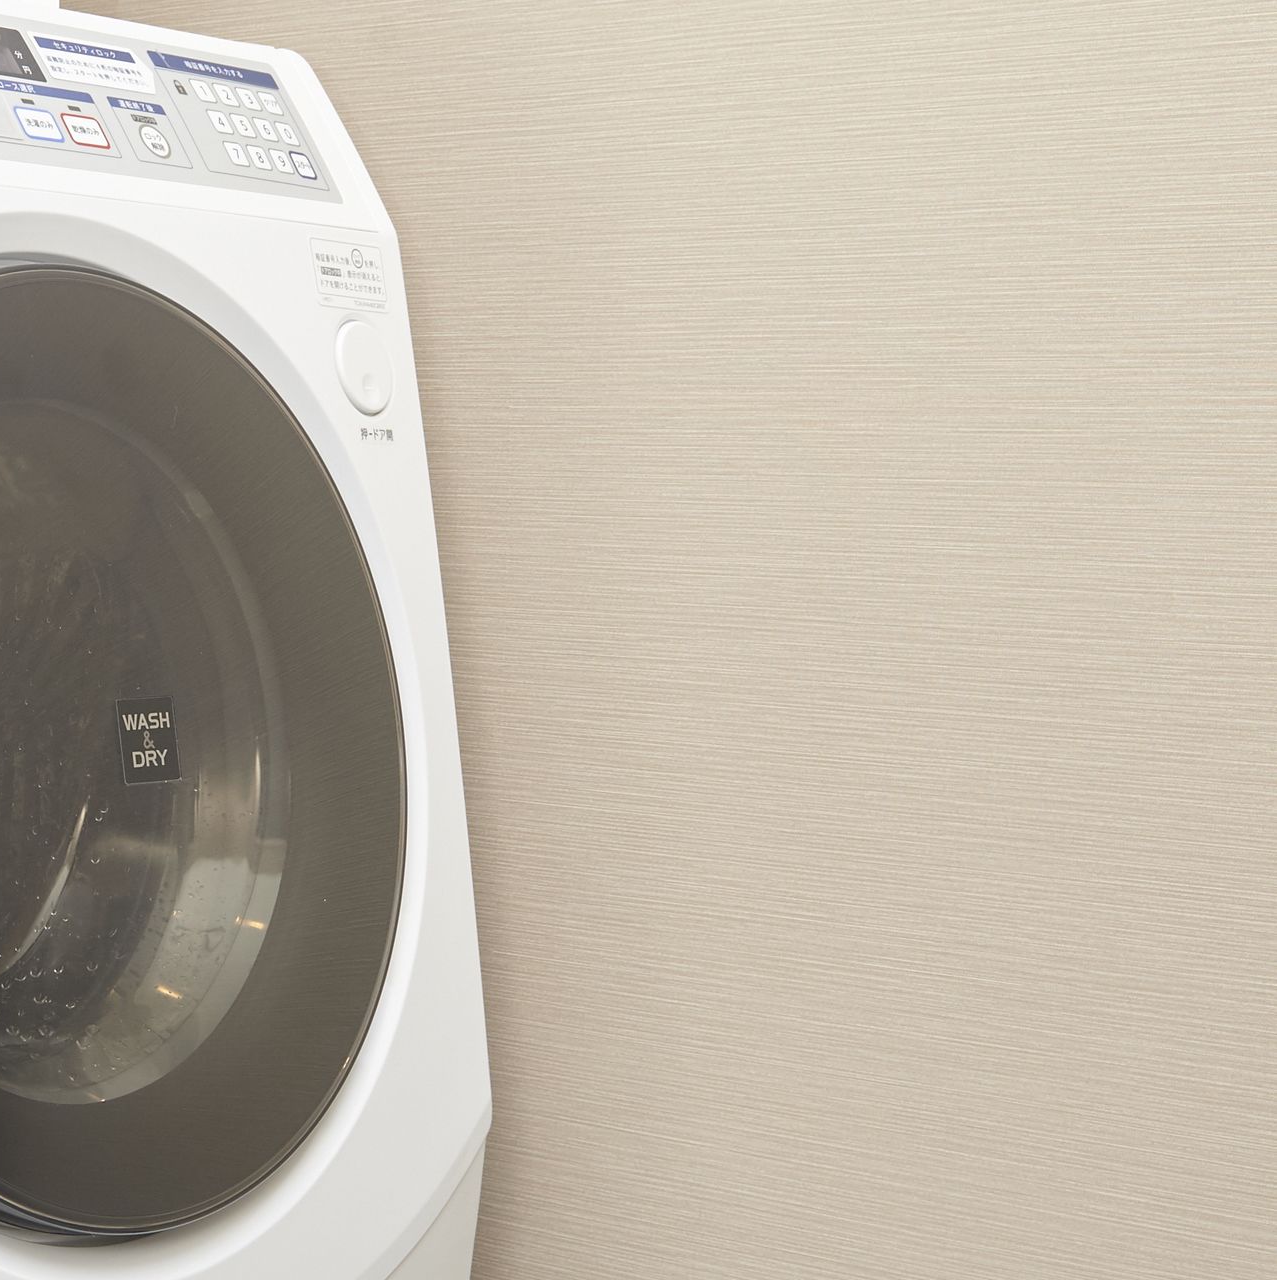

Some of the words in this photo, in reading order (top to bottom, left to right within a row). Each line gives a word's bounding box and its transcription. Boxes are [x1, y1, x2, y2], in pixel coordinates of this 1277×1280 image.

[53, 42, 116, 58] セキュリティロック
[222, 89, 231, 100] 2
[244, 94, 254, 104] 3
[26, 119, 54, 130] 洗濯のみ
[218, 117, 225, 126] 4
[240, 120, 248, 131] 5
[263, 124, 270, 135] 6
[256, 152, 264, 163] 8
[278, 156, 286, 166] 9
[122, 712, 170, 730] WASH
[144, 731, 155, 749] &
[132, 749, 167, 768] DRY
